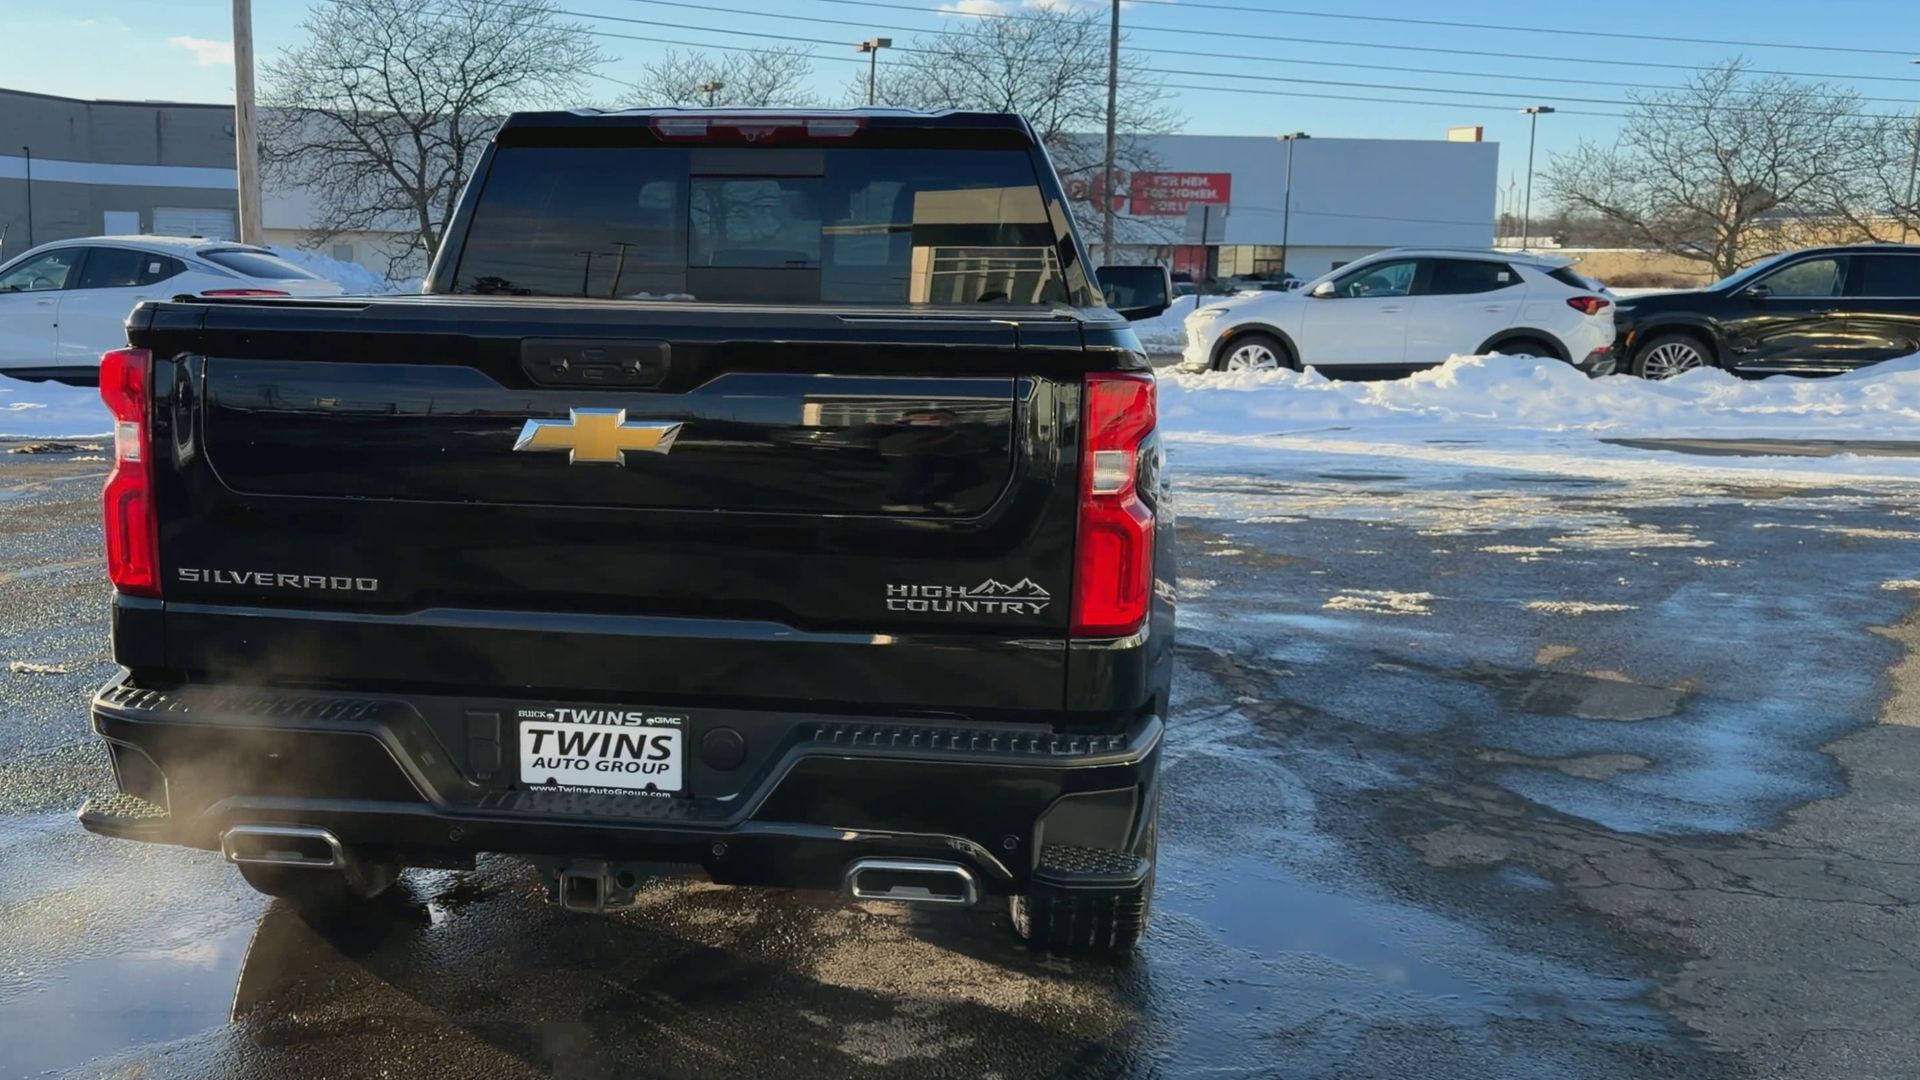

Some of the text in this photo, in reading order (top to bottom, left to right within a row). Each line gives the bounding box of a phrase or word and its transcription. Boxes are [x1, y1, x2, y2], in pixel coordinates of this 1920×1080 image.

[178, 567, 378, 591] SILVERADO
[886, 584, 967, 598] HIGH
[886, 598, 1049, 614] COUNTRY
[518, 708, 681, 726] BUICK TWINS GMC
[527, 729, 673, 761] TWINS
[532, 757, 670, 775] AUTO GROUP
[530, 785, 671, 798] www.TwinsAutoGroup.com
